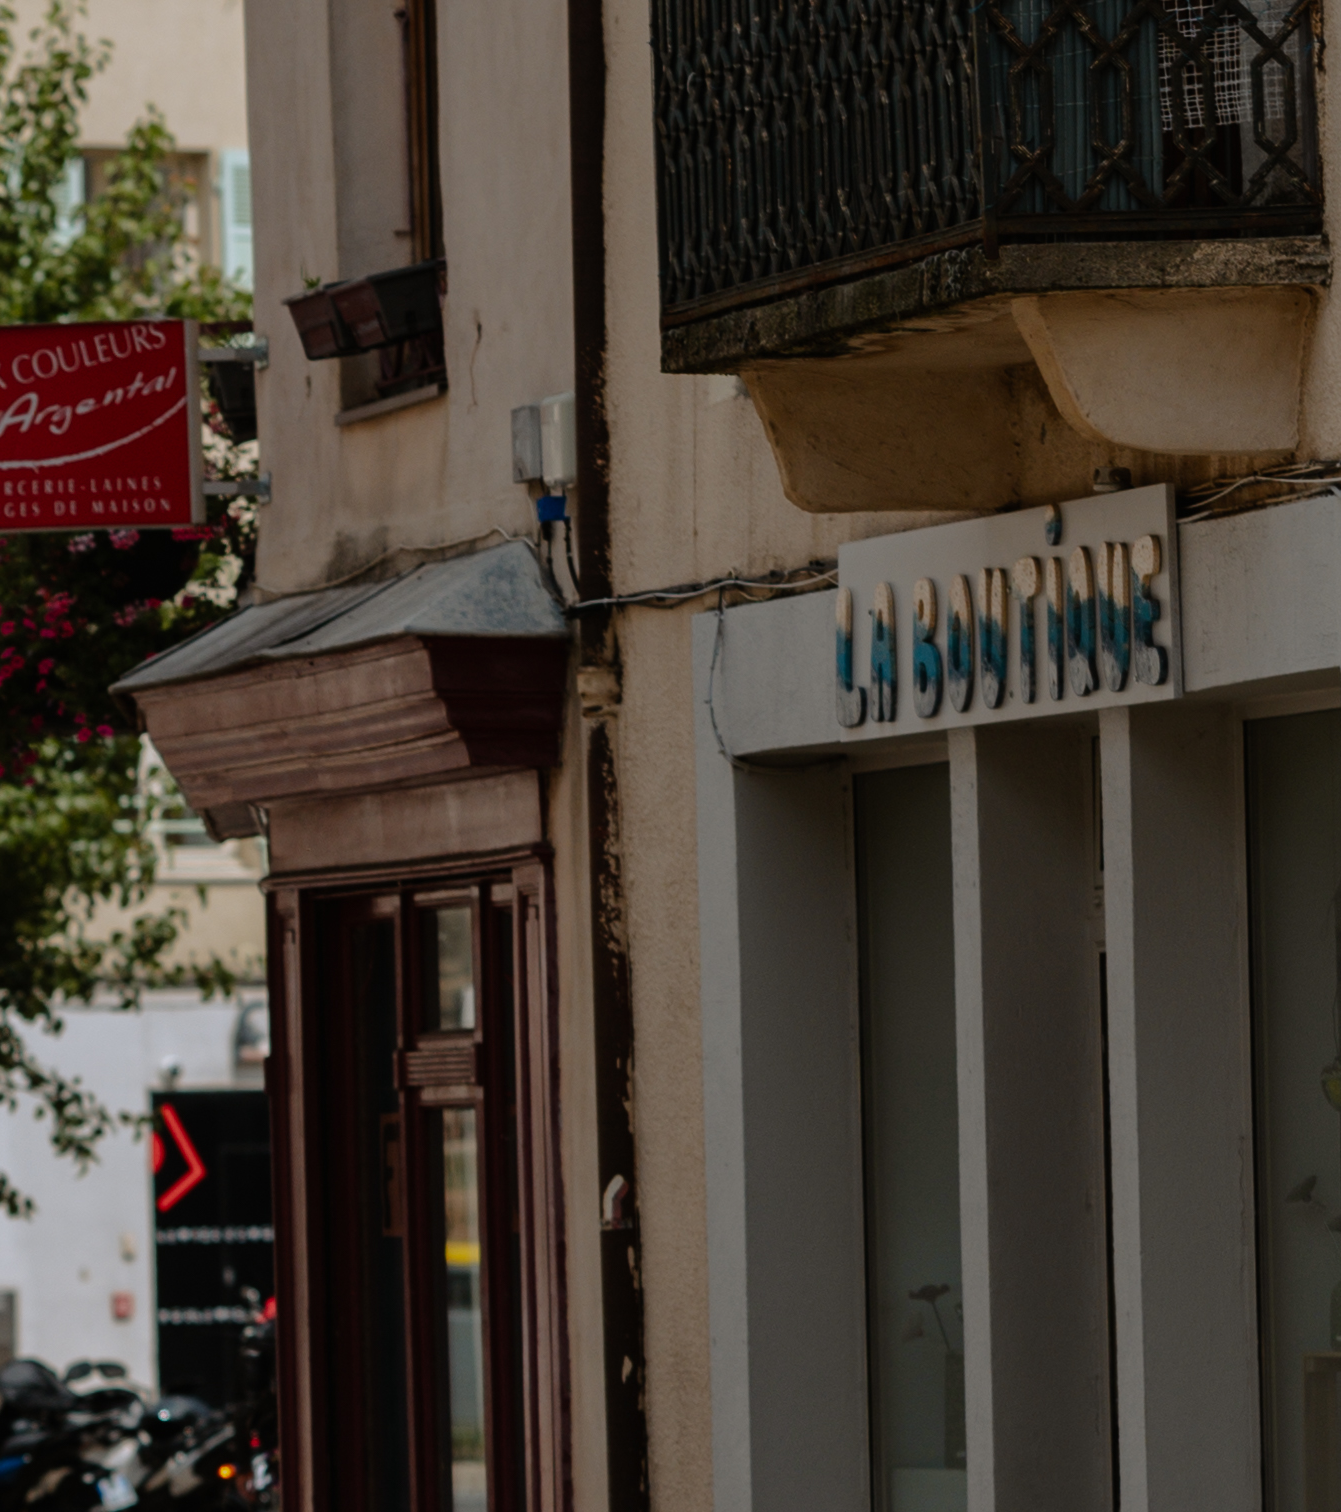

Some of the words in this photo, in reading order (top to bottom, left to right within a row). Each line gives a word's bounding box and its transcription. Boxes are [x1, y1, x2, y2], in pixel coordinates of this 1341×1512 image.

[11, 324, 167, 384] COULEURS
[54, 500, 78, 517] DE
[91, 498, 172, 515] MAISON
[835, 581, 898, 728] LA
